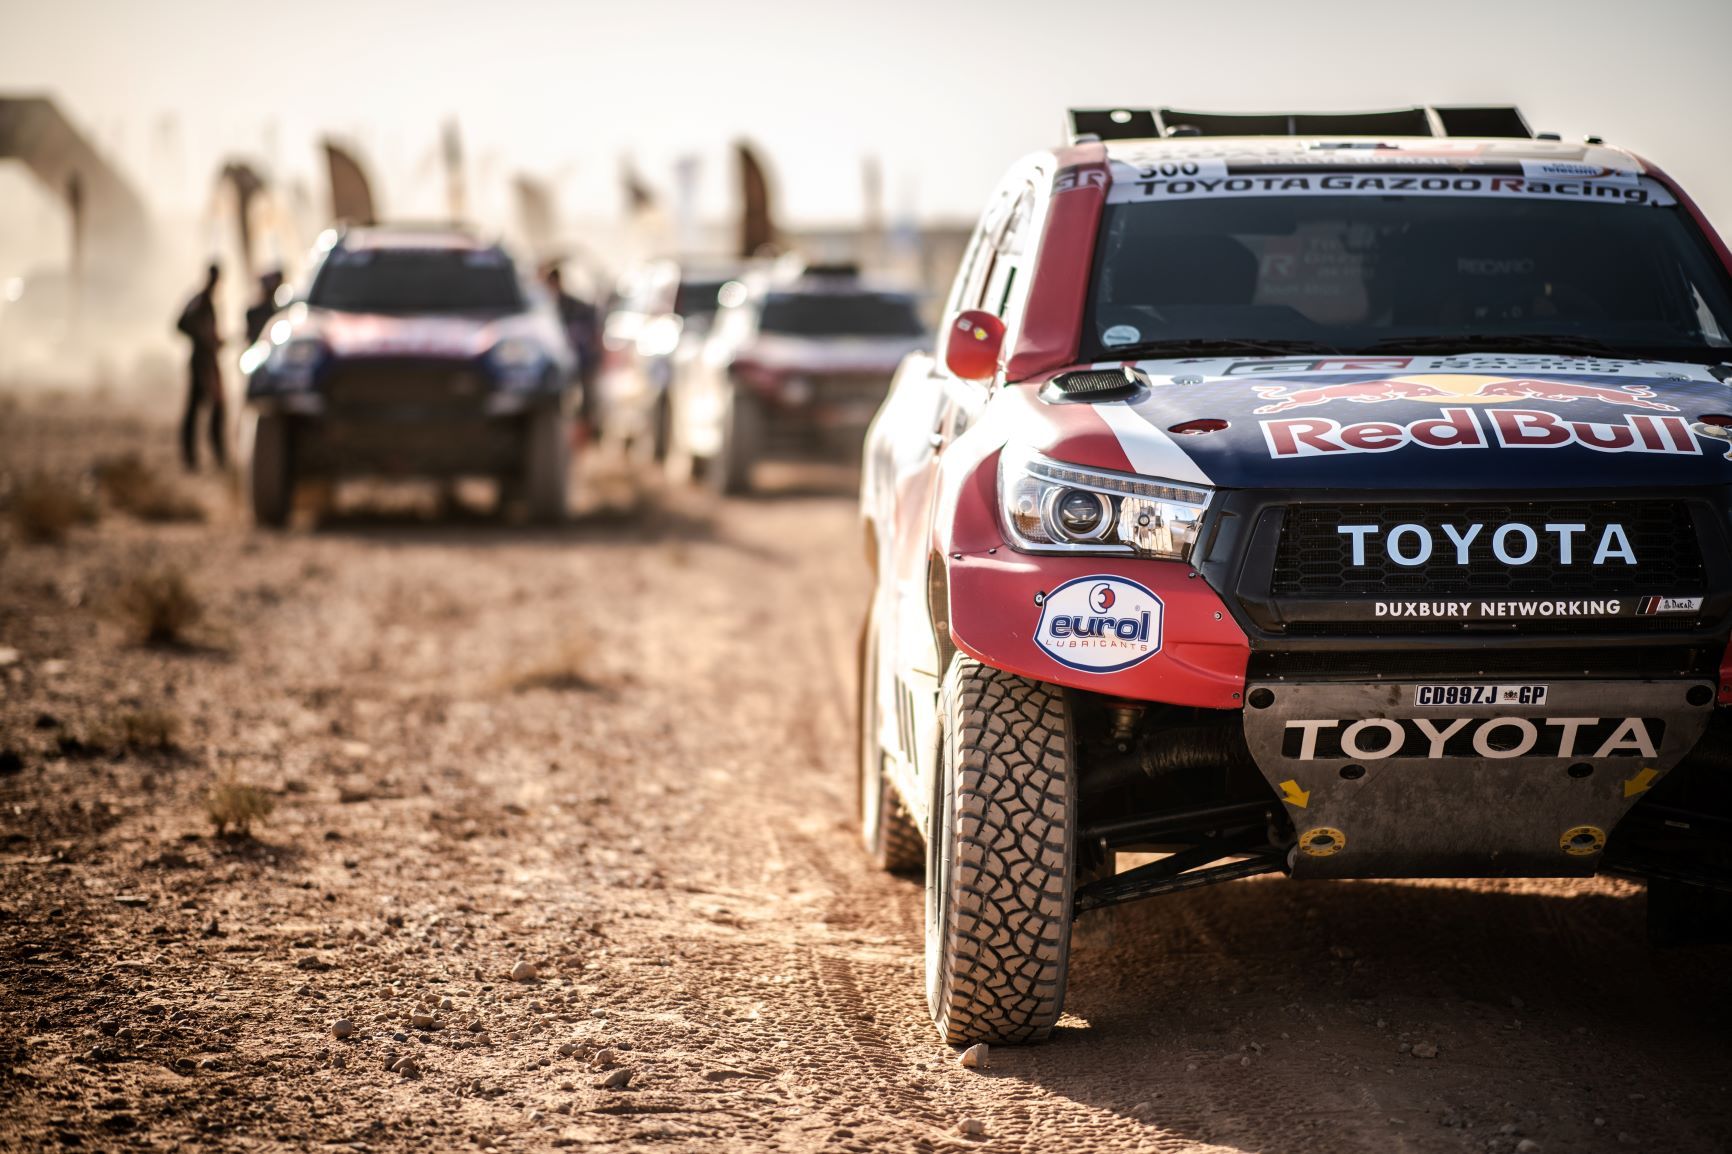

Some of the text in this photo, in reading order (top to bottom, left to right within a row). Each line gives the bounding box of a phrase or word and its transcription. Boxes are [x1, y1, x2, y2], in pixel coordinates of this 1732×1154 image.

[1053, 169, 1107, 192] GR
[1134, 176, 1648, 204] TOYOTA GAZOO Racing
[1259, 408, 1702, 459] Red Bull
[1337, 523, 1638, 566] TOYOTA
[1375, 599, 1621, 617] DUXBURY NETWORKING
[1050, 611, 1151, 642] eurol
[1045, 639, 1148, 652] LUBRICANTS
[1419, 686, 1545, 704] CD99ZJ GP
[1285, 717, 1658, 760] TOYOTA
